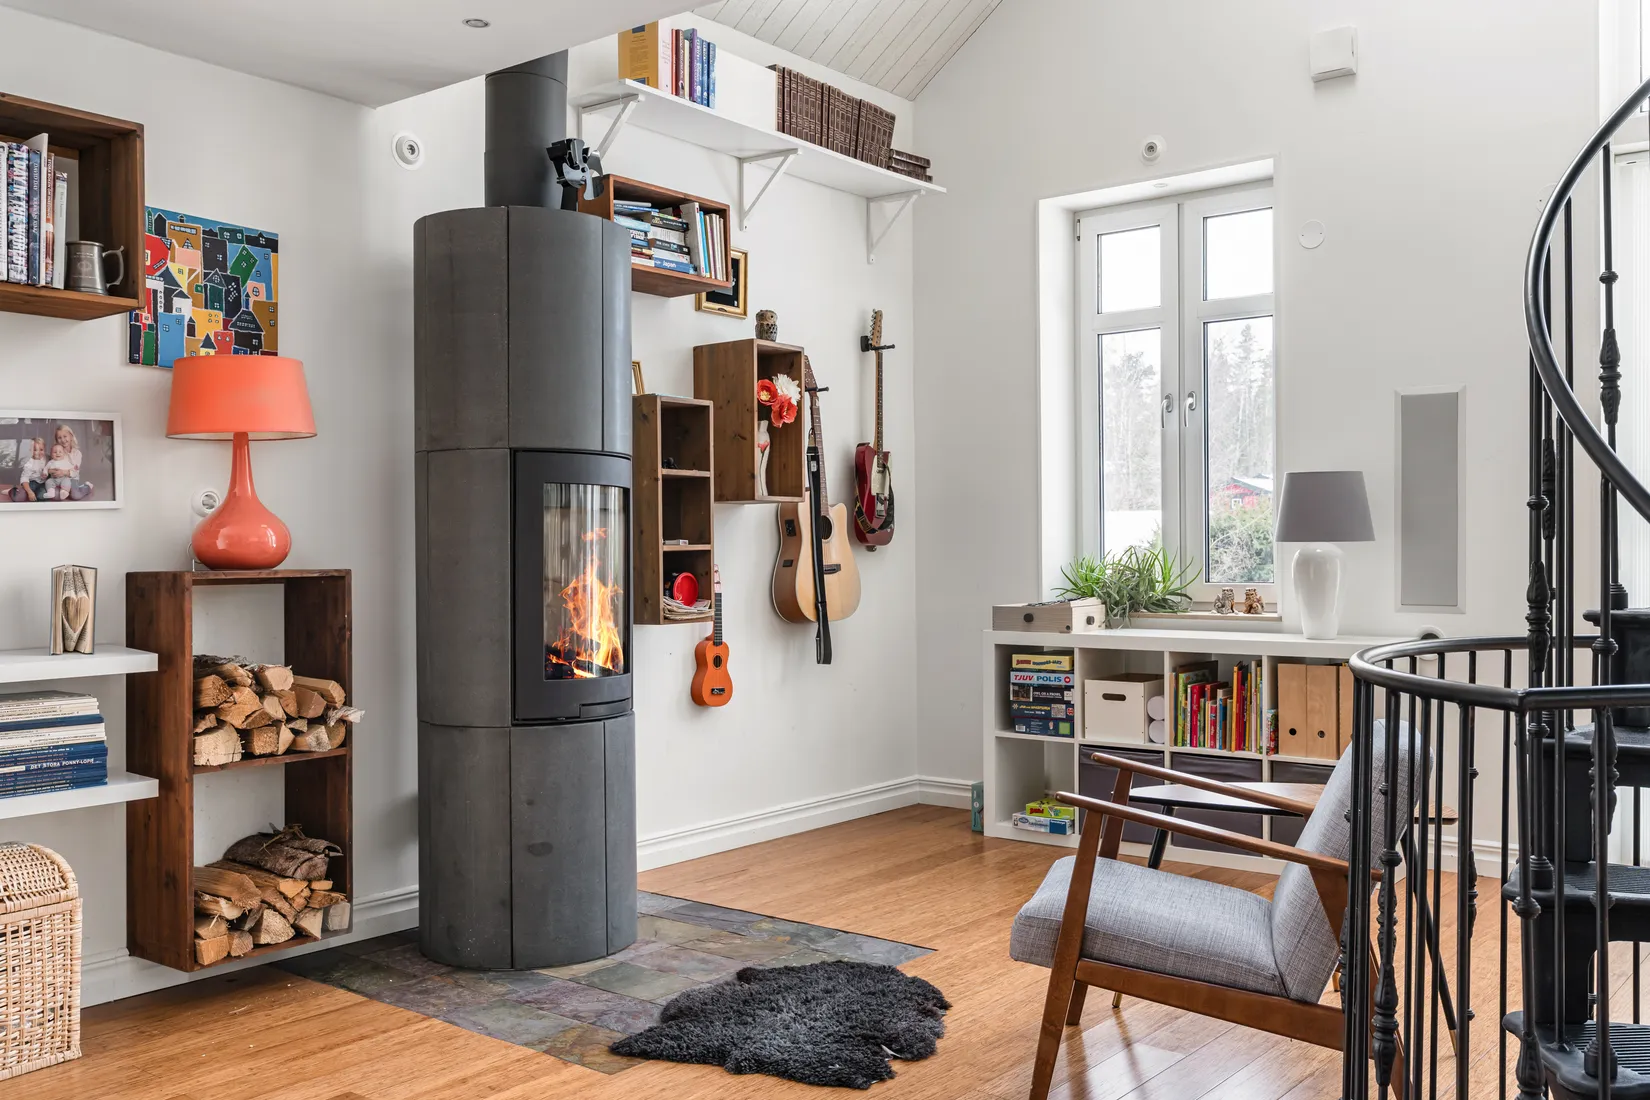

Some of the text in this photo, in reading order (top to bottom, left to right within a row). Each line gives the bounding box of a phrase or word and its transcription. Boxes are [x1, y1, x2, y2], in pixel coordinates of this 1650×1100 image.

[13, 150, 27, 267] A DAY IN THE WORLD
[662, 260, 677, 268] Japan
